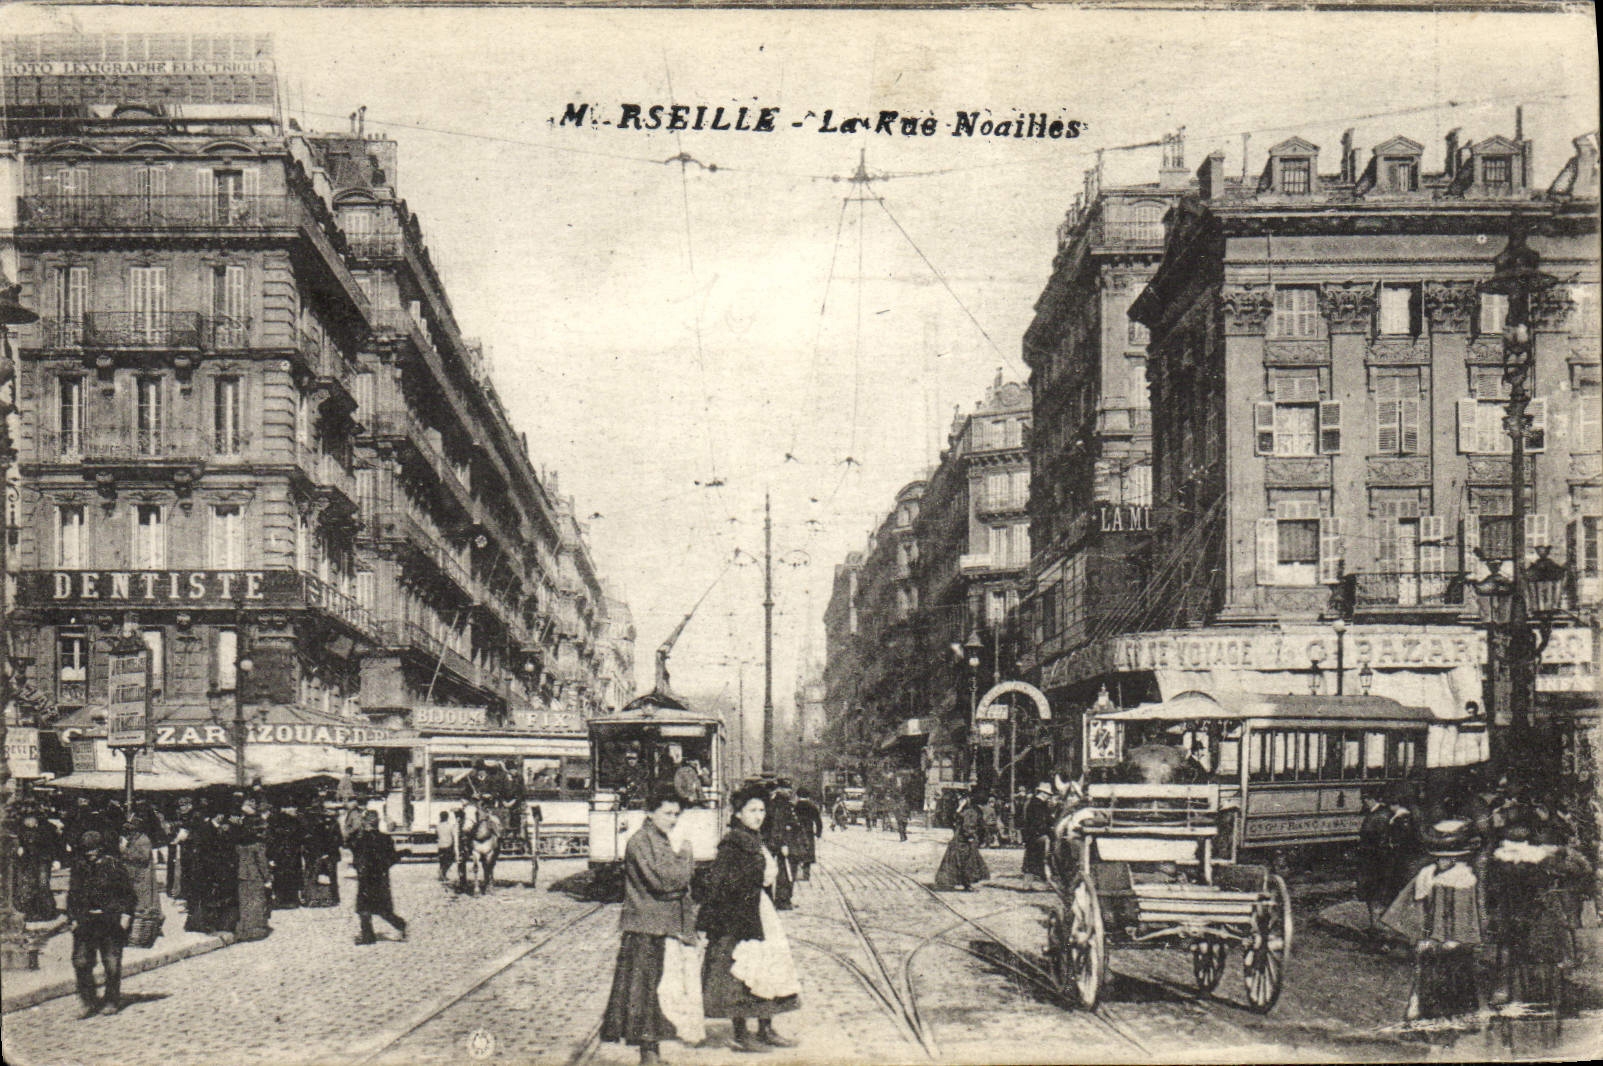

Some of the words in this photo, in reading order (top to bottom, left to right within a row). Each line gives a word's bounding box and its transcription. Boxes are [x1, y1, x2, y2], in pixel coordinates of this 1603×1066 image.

[1100, 507, 1123, 532] LA
[53, 572, 264, 600] DENTISTE
[157, 724, 228, 745] ZAR
